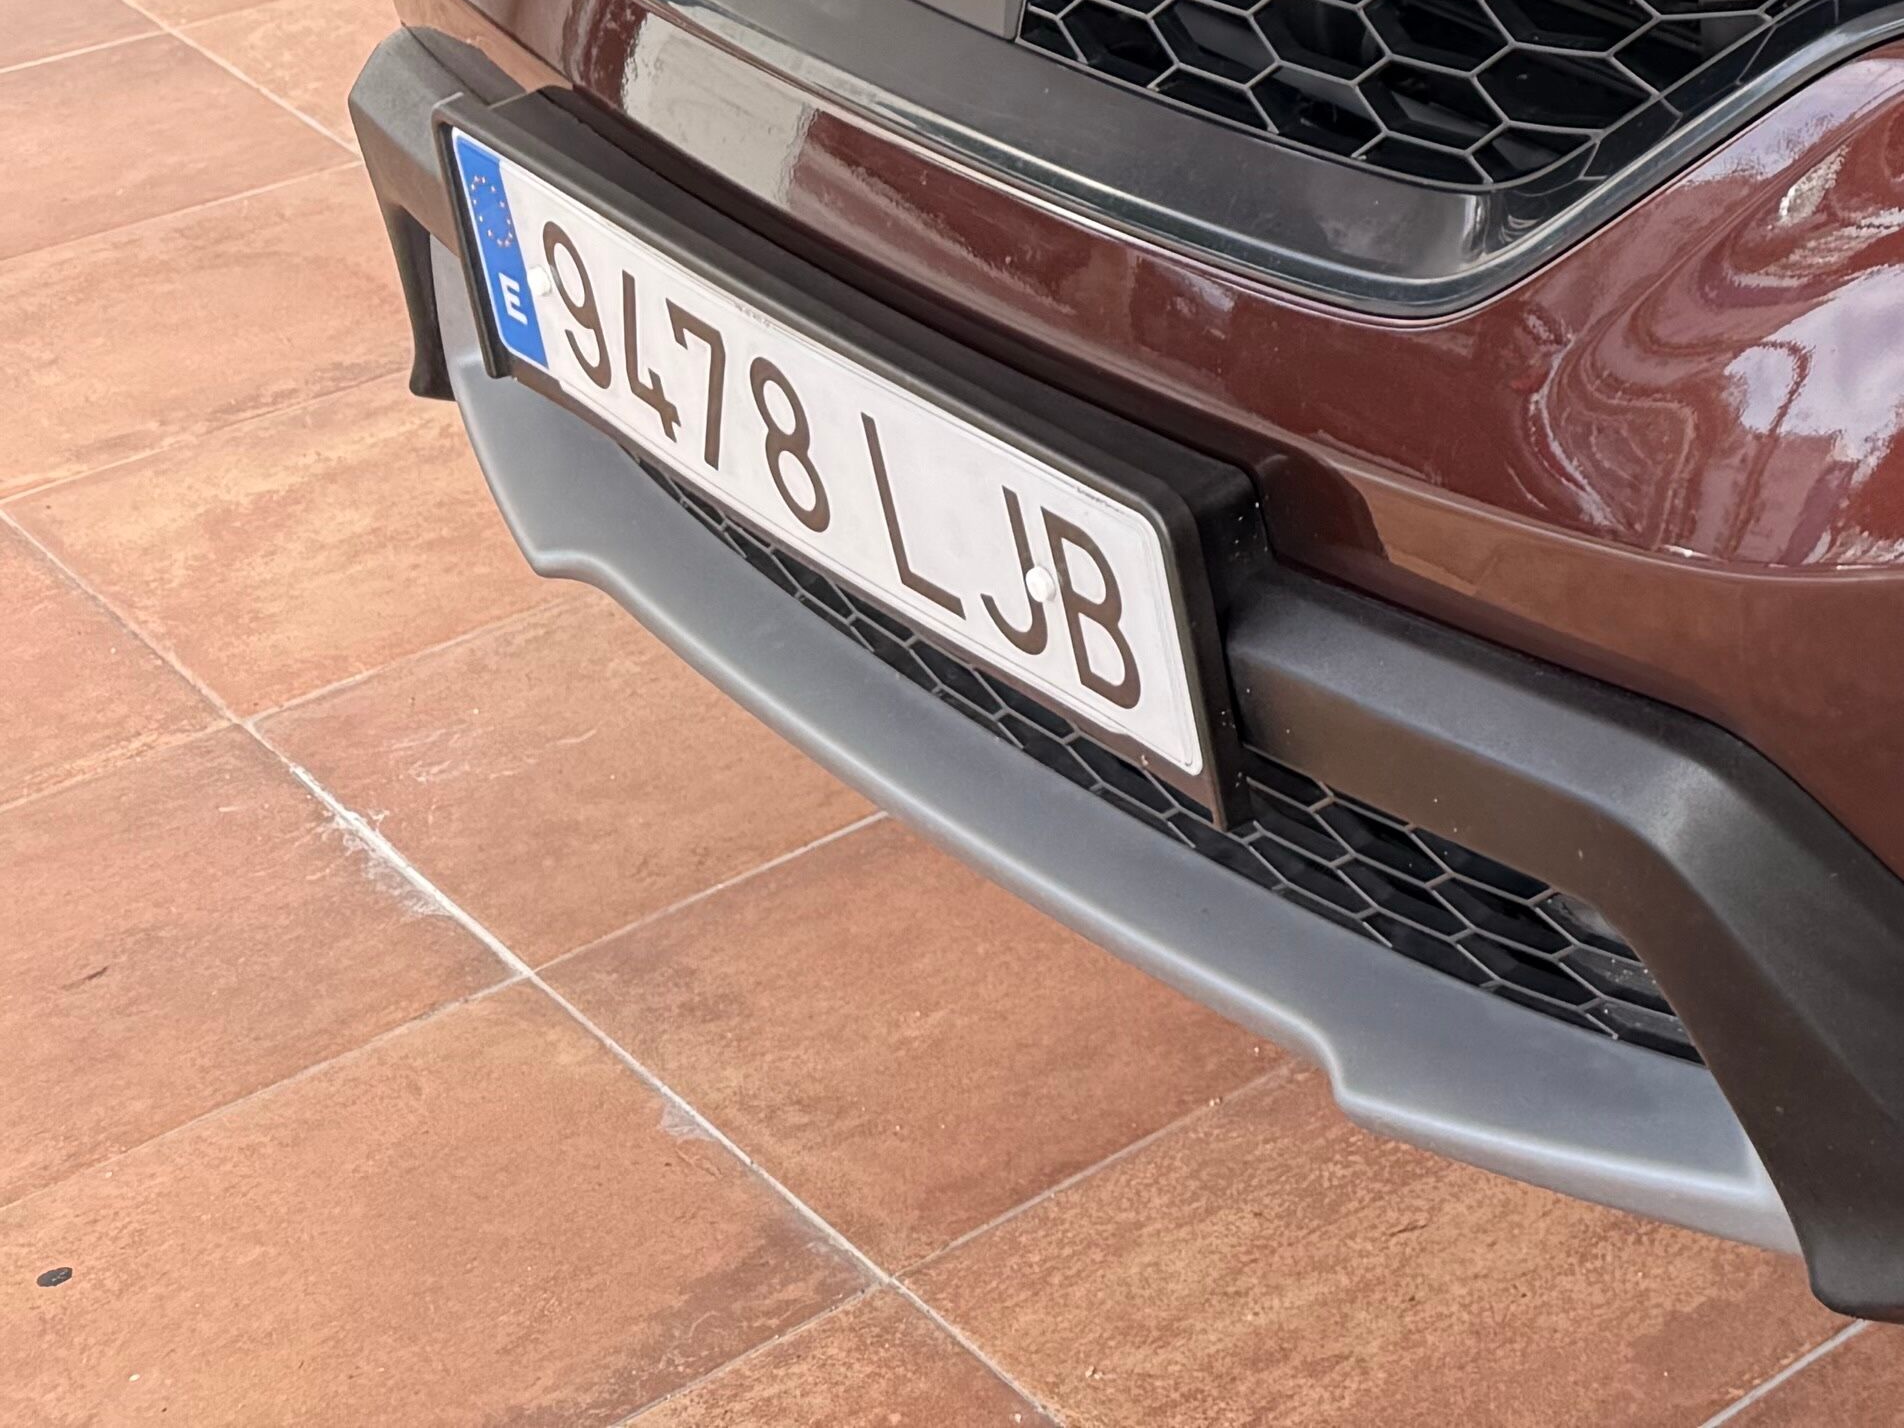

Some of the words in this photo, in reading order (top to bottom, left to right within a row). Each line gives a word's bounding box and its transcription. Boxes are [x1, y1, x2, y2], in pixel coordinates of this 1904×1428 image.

[496, 271, 530, 325] E
[541, 220, 831, 533] 9478
[859, 411, 1142, 710] LJB
